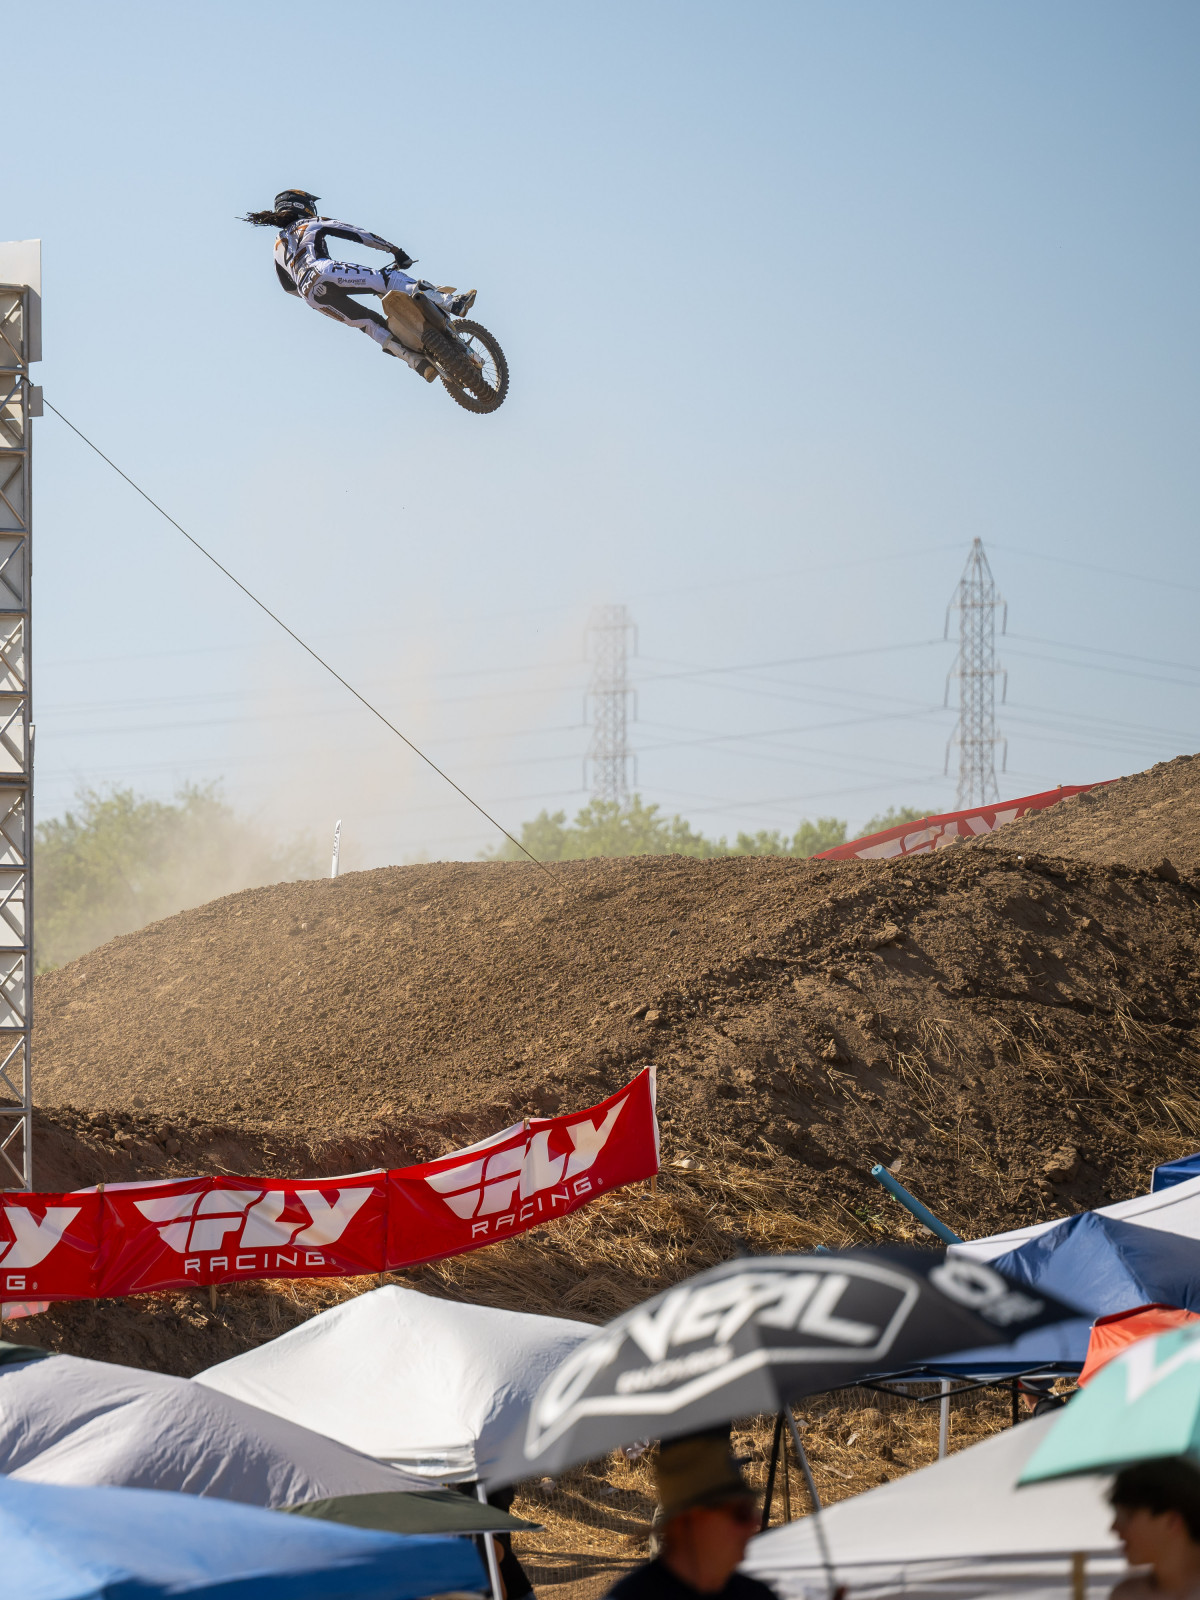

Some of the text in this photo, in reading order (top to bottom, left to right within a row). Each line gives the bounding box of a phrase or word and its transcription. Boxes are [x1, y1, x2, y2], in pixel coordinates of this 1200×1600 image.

[424, 1093, 630, 1220] FLY
[133, 1187, 375, 1254] FLY
[471, 1177, 593, 1239] RACING
[184, 1252, 325, 1275] RACING
